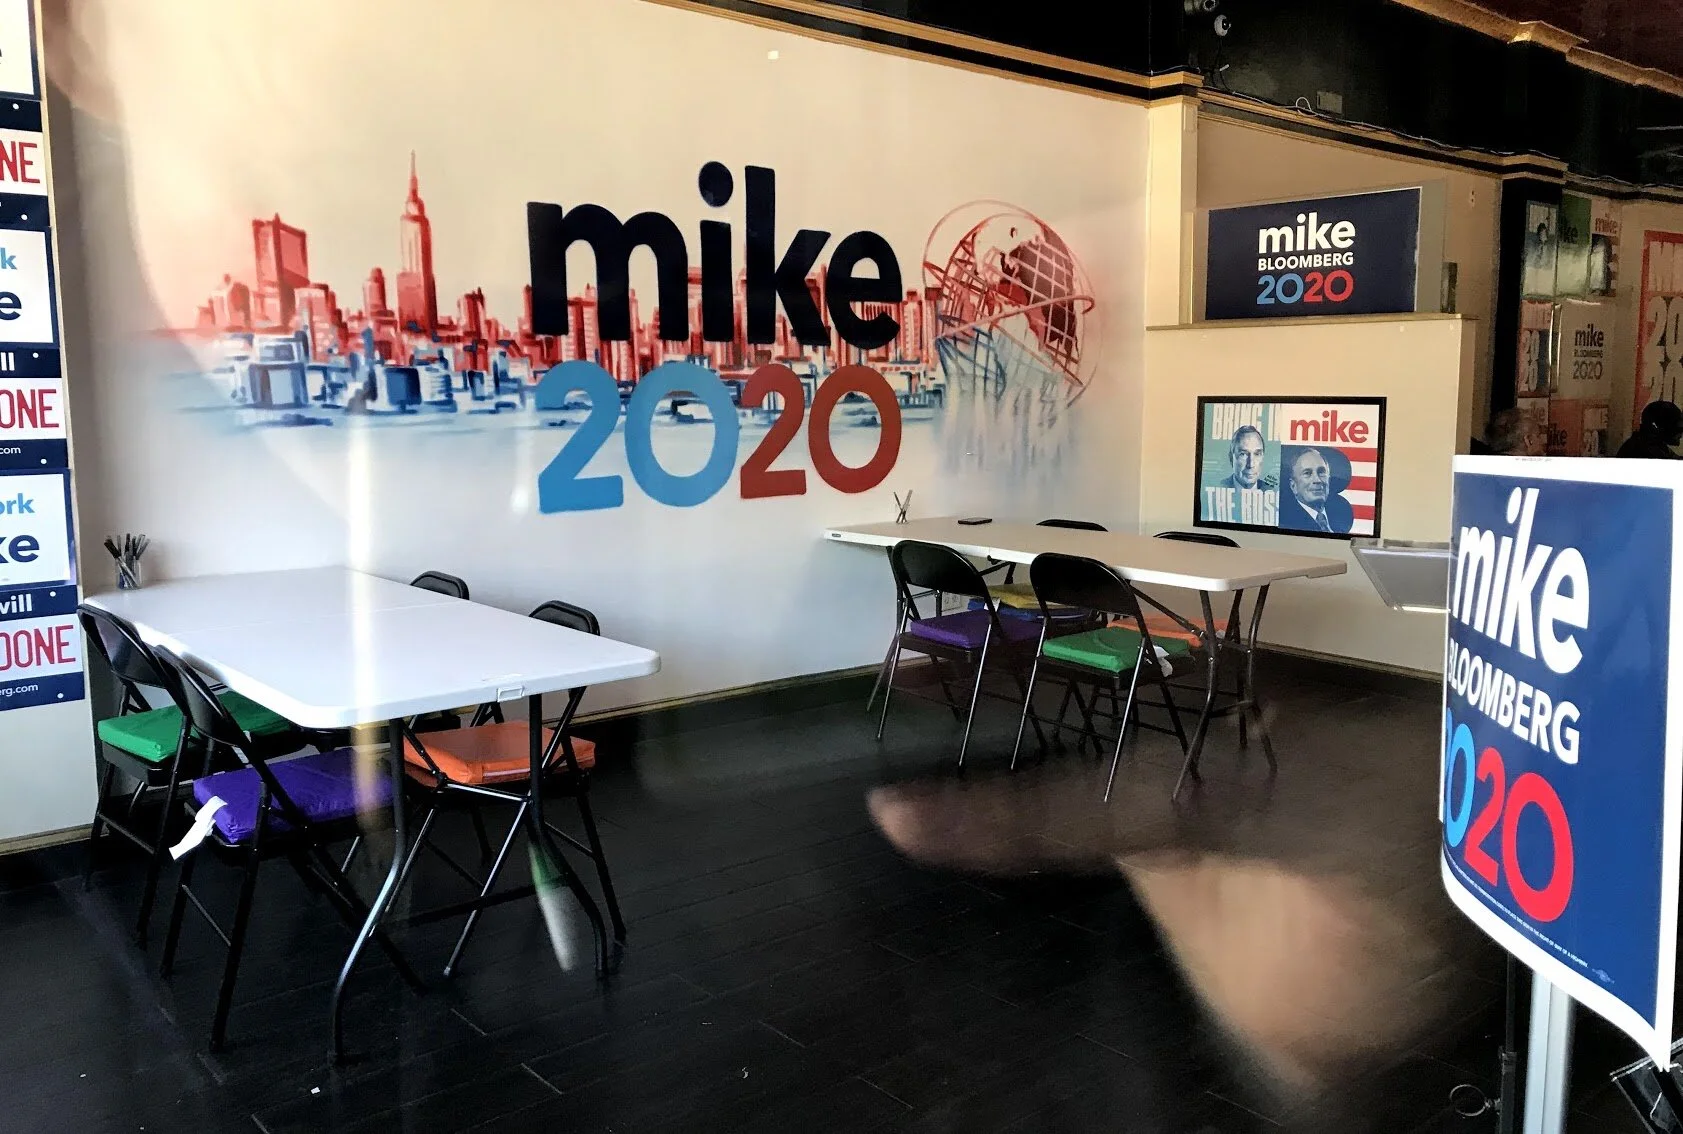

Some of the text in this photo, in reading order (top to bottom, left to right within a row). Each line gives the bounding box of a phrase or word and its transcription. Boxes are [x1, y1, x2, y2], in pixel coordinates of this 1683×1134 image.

[1258, 212, 1356, 254] mike
[526, 161, 903, 350] mike
[1258, 252, 1354, 271] BLOOMBERG
[1256, 270, 1354, 305] 2020
[1574, 324, 1604, 347] mike
[1573, 361, 1604, 380] 2020
[535, 360, 902, 514] 2020
[1290, 410, 1369, 444] mike
[1205, 487, 1280, 526] THE BOS
[1452, 486, 1590, 674] mike
[0, 684, 39, 697] rg.com
[1449, 637, 1581, 765] BLOOMBERG
